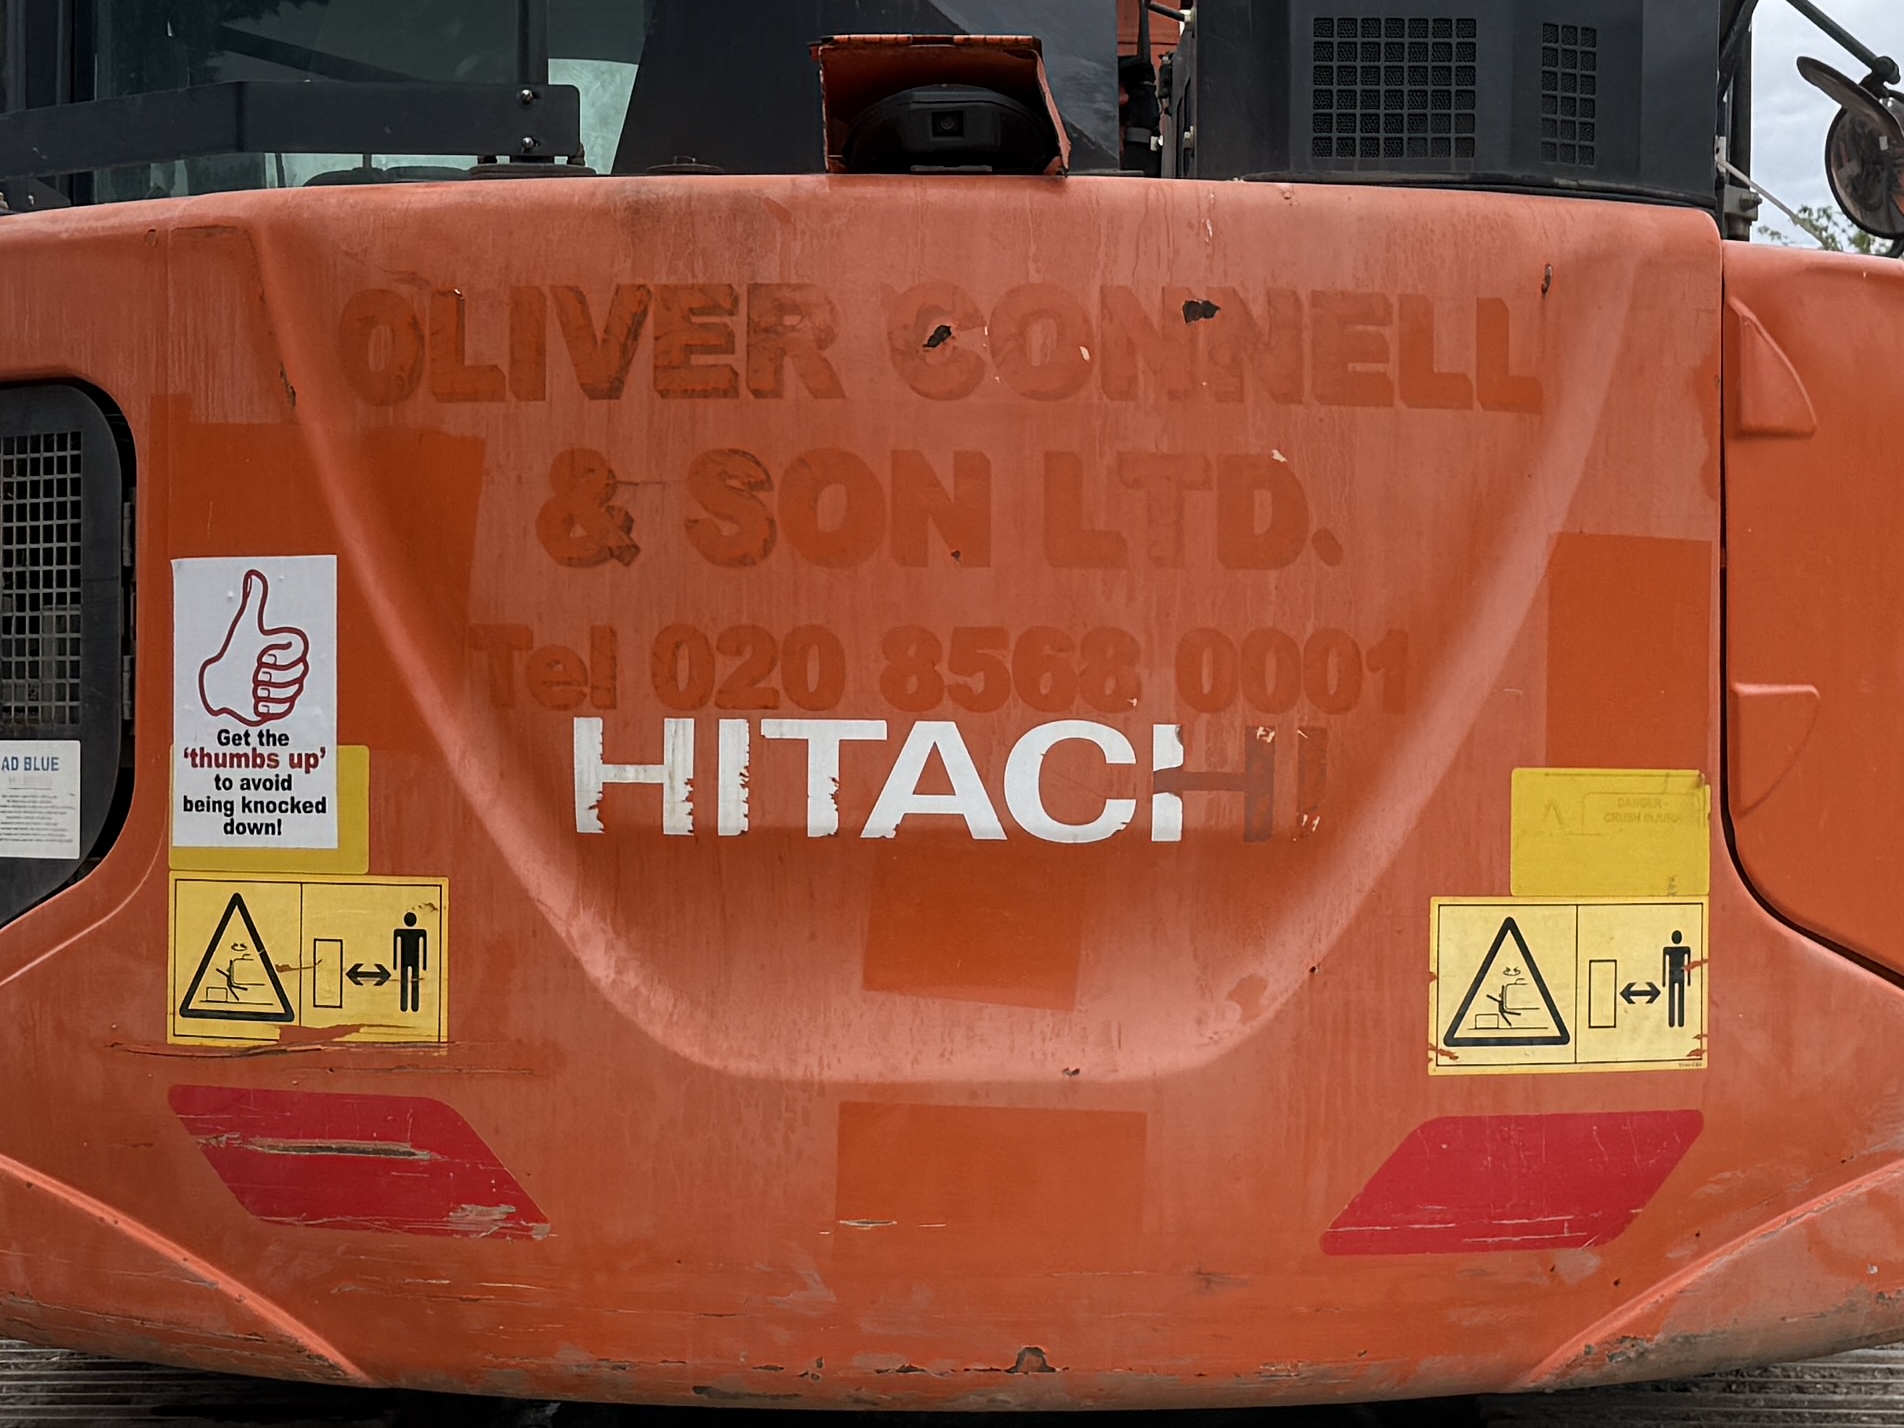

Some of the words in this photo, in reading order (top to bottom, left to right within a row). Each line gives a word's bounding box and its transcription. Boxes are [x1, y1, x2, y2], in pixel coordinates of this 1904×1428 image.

[338, 282, 846, 408] OLIVER
[887, 282, 1544, 415] CONNELL
[536, 448, 641, 569] &
[685, 448, 992, 569] SON
[1043, 450, 1344, 570] LTD.
[468, 623, 617, 711] Tel
[651, 624, 846, 712] 020
[879, 625, 1142, 714] 8568
[1174, 628, 1411, 716] 0001
[217, 729, 251, 747] Get
[257, 729, 290, 747] the
[1, 756, 19, 772] AD
[23, 756, 59, 772] BLUE
[214, 774, 233, 791] to
[240, 774, 292, 791] avoid
[573, 716, 1328, 844] HITACHI
[183, 795, 235, 817] being
[242, 796, 327, 814] knocked
[223, 818, 282, 836] down!
